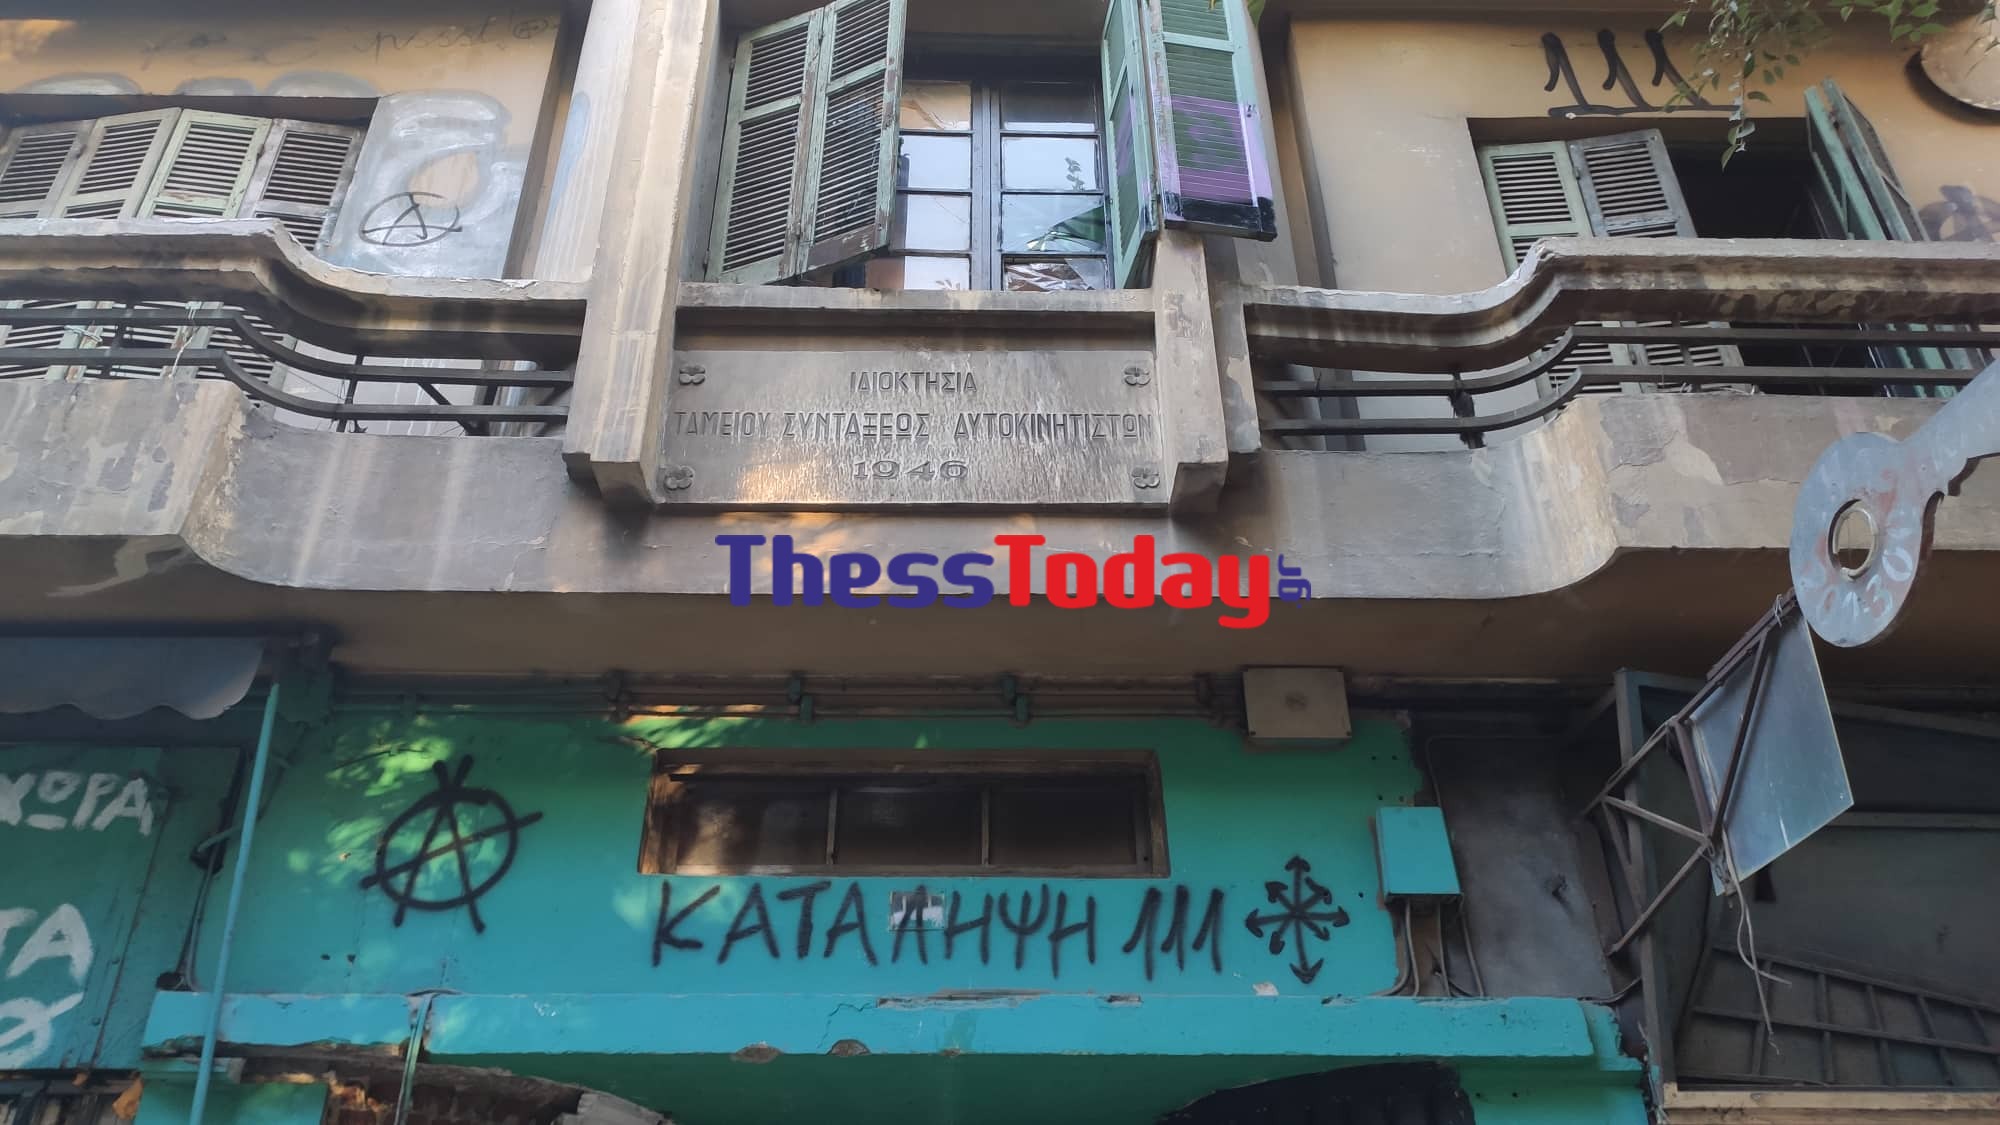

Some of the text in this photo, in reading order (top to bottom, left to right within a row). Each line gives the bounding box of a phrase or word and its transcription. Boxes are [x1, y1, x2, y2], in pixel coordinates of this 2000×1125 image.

[850, 370, 977, 394] ΙΔΙΟΚΤΗΣΙΑ
[673, 411, 1152, 440] ΤΑΜΕΙΟΥ ΣΥΝΤΑΞΕΩΣ ΑΥΤΟΚΙΝΗΤΙΣΤΩΝ
[854, 460, 968, 480] 1946
[651, 880, 1096, 979] ΚΑΤΑΛΗΨΗ
